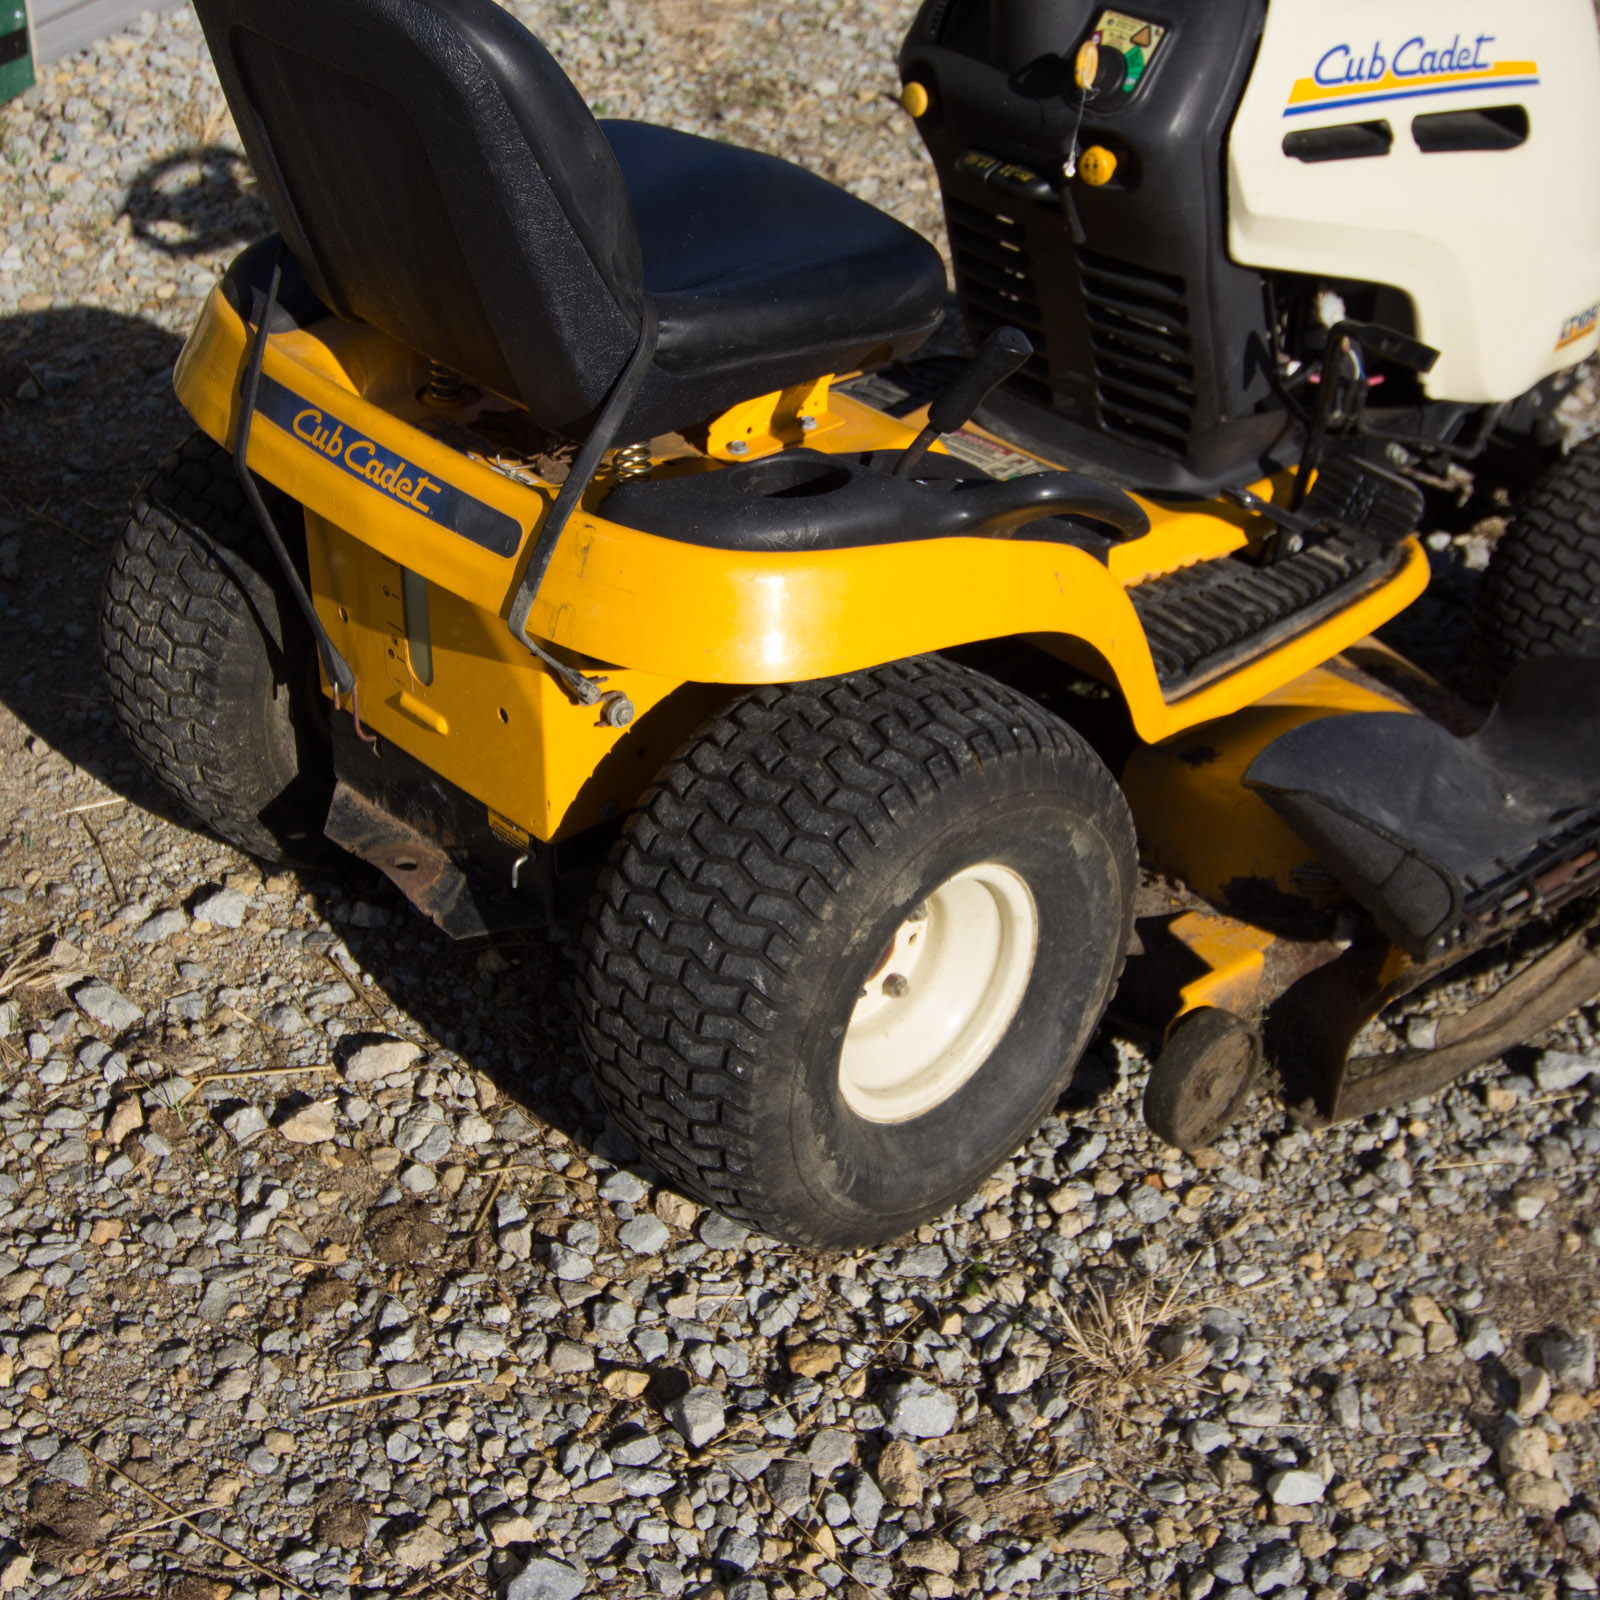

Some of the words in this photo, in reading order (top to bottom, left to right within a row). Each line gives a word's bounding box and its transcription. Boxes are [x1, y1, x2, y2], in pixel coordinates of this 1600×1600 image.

[1314, 41, 1386, 86] Cub
[1392, 34, 1496, 77] Cadet
[293, 409, 343, 458] Cub
[344, 440, 442, 514] Cadet
